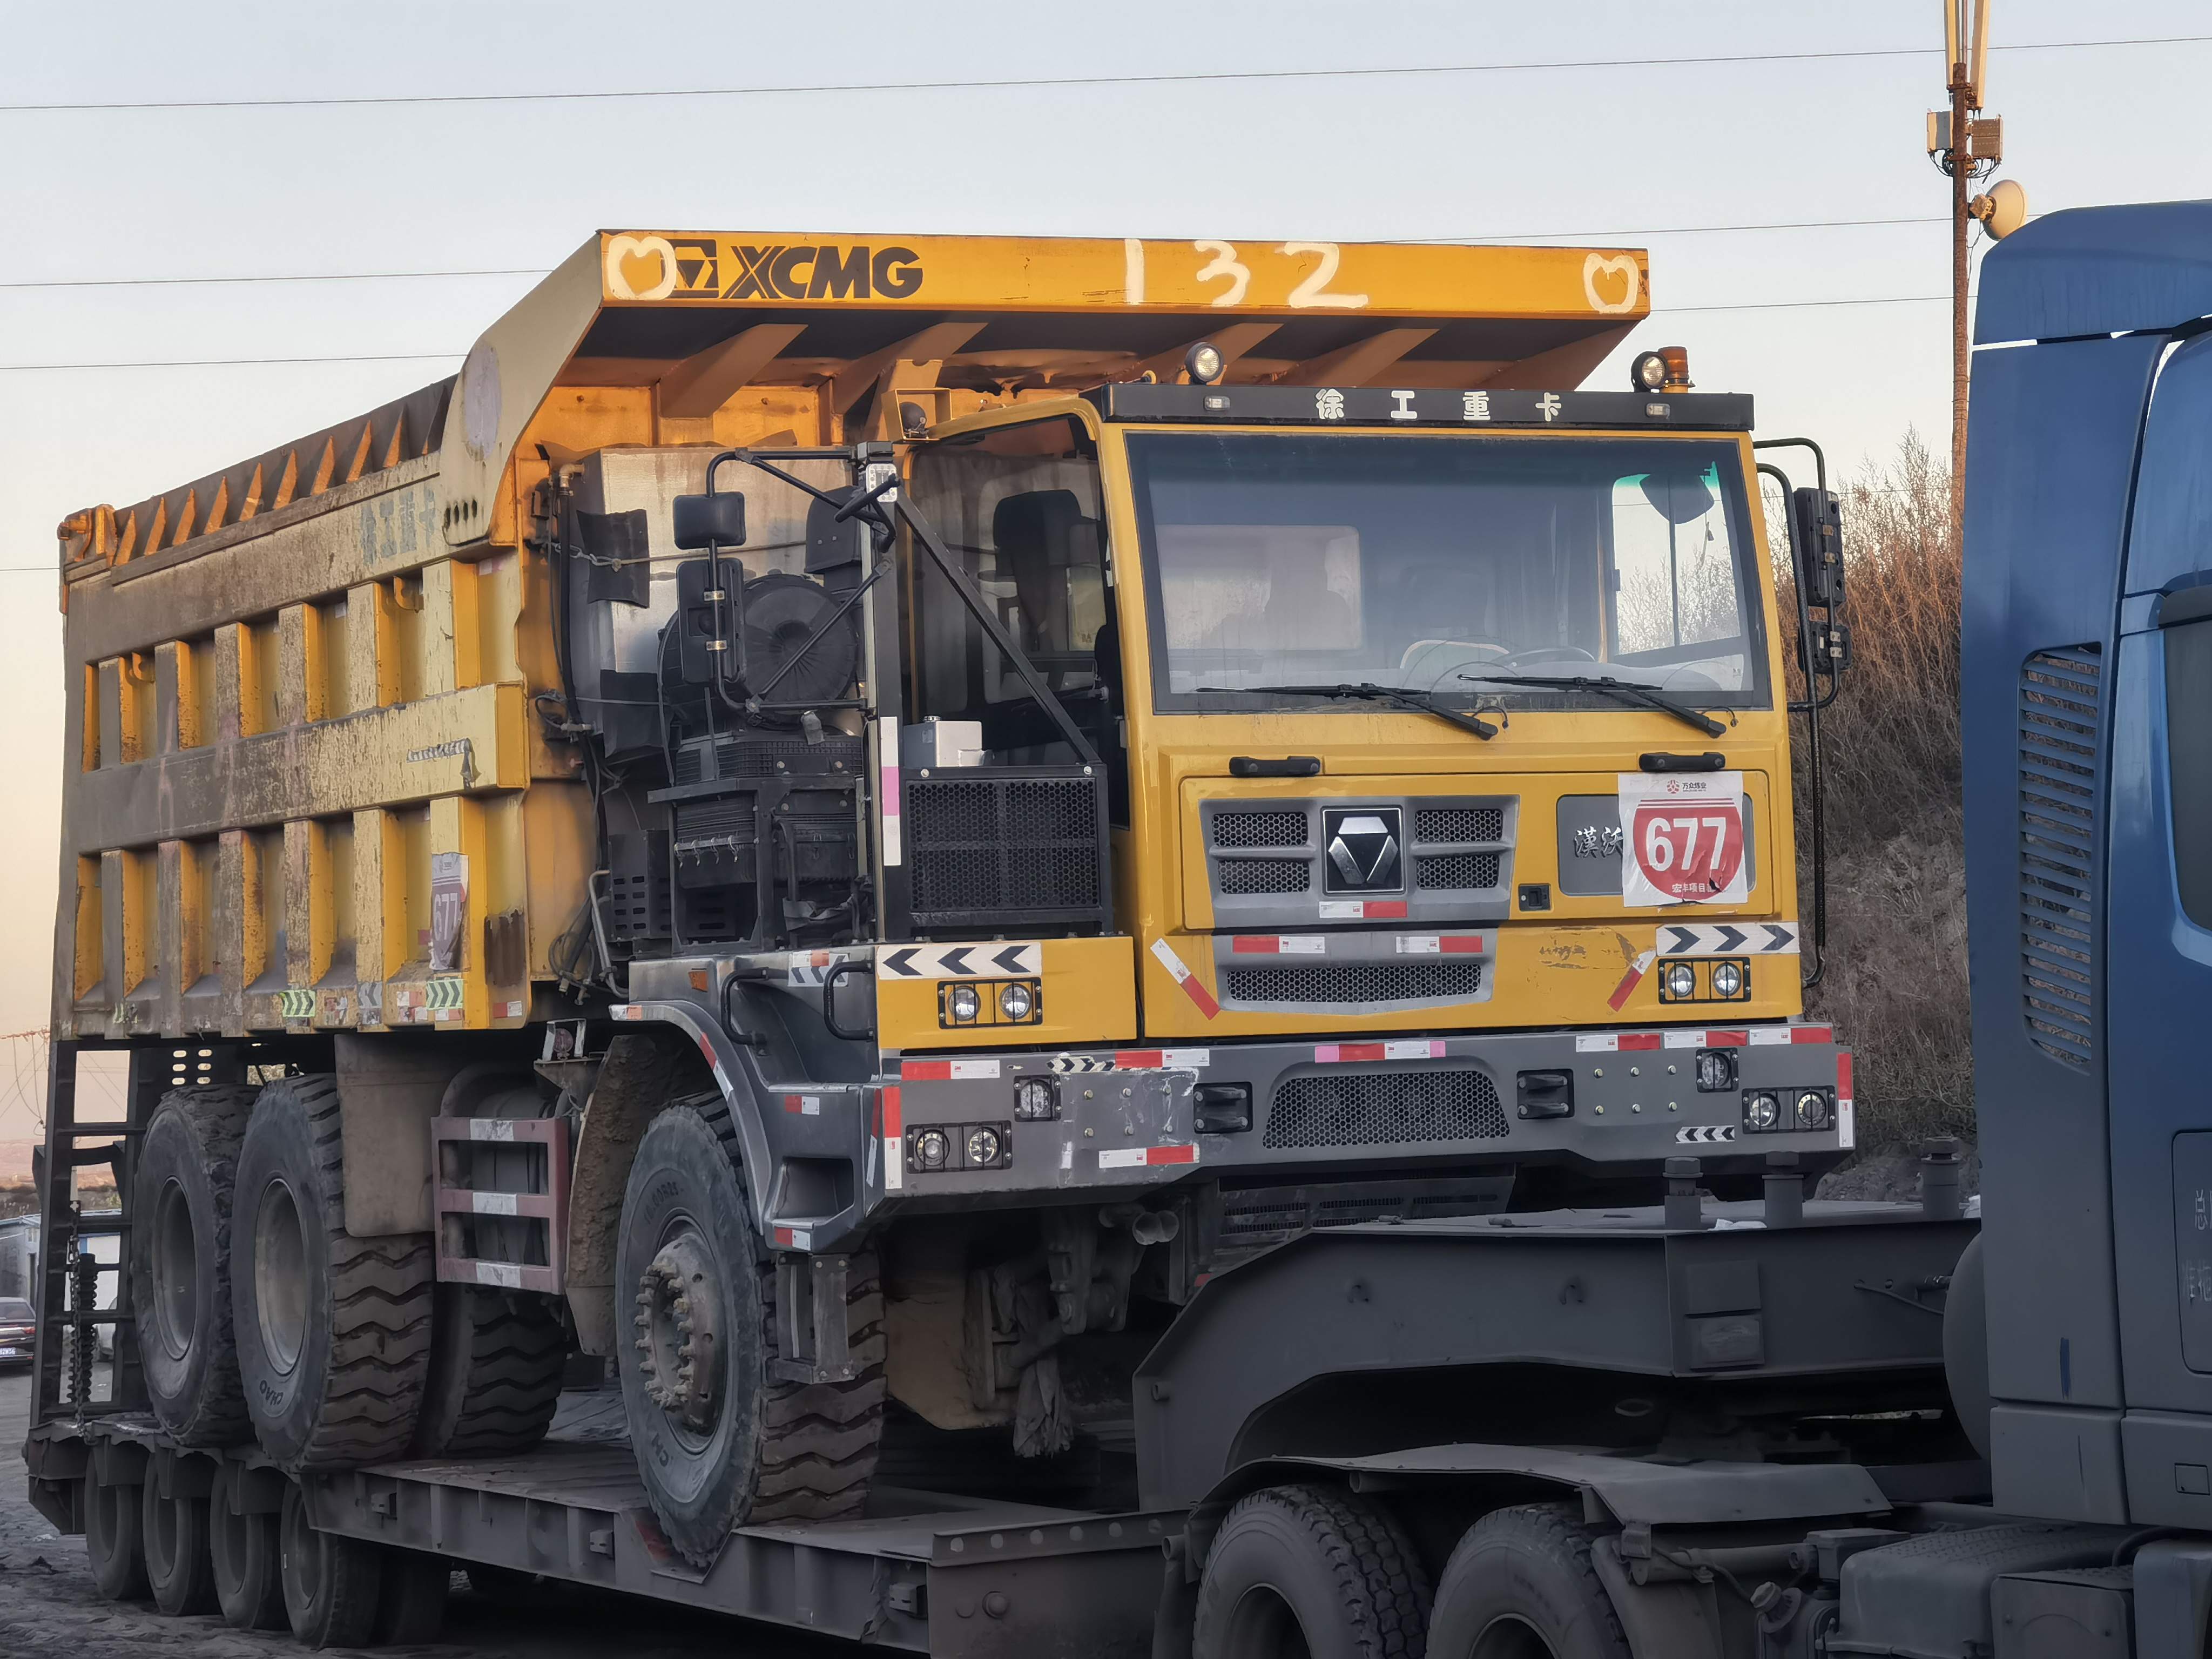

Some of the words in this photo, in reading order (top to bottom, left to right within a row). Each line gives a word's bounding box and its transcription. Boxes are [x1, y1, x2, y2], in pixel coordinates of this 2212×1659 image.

[720, 246, 923, 299] XCMG
[1314, 388, 1561, 421] 徐工重卡
[1645, 817, 1727, 872] 677
[433, 893, 461, 941] 677
